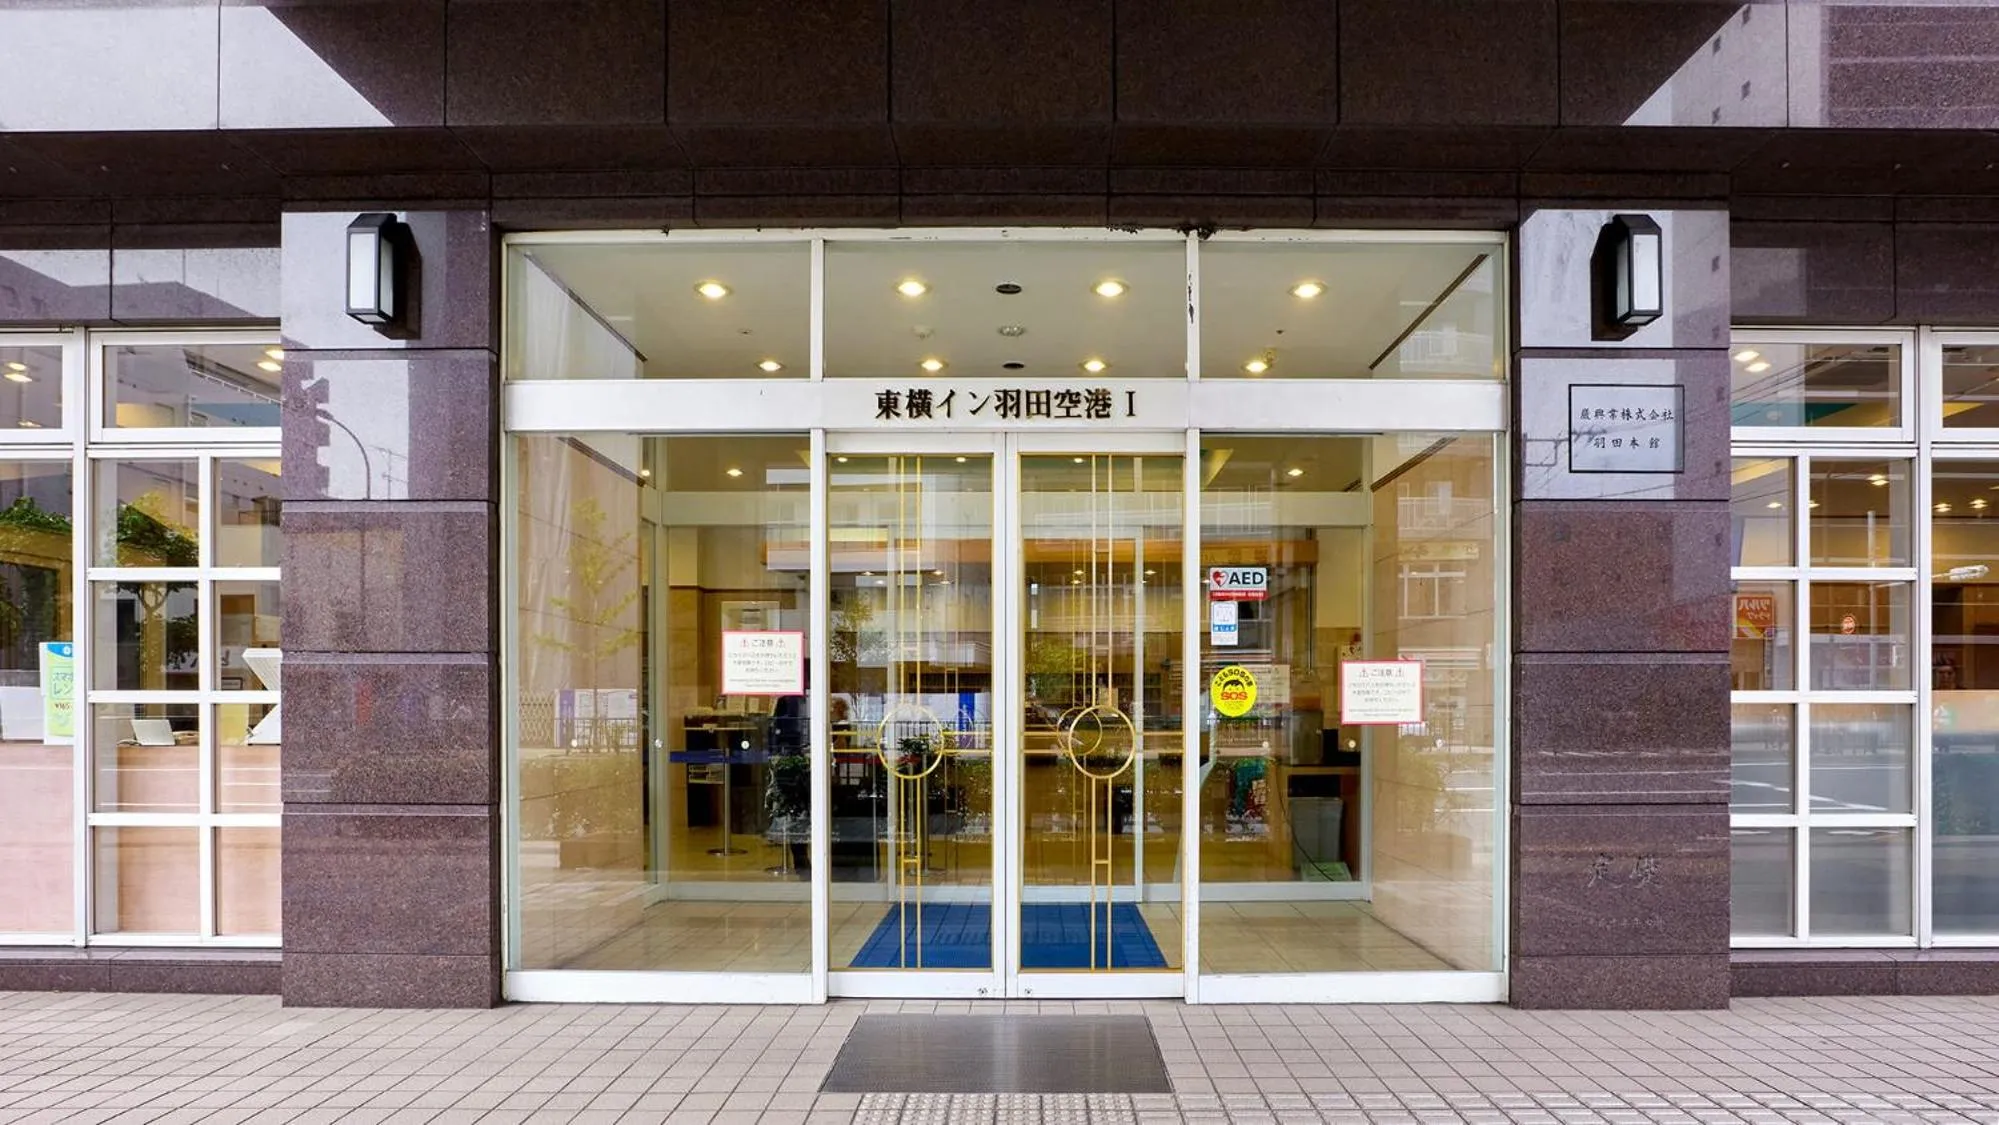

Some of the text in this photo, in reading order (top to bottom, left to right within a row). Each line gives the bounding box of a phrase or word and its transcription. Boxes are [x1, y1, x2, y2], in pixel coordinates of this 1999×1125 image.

[874, 388, 1113, 420] 東横イン羽田空港
[1593, 436, 1661, 450] 羽田本館
[1228, 571, 1264, 585] AED
[1220, 691, 1248, 701] SOS
